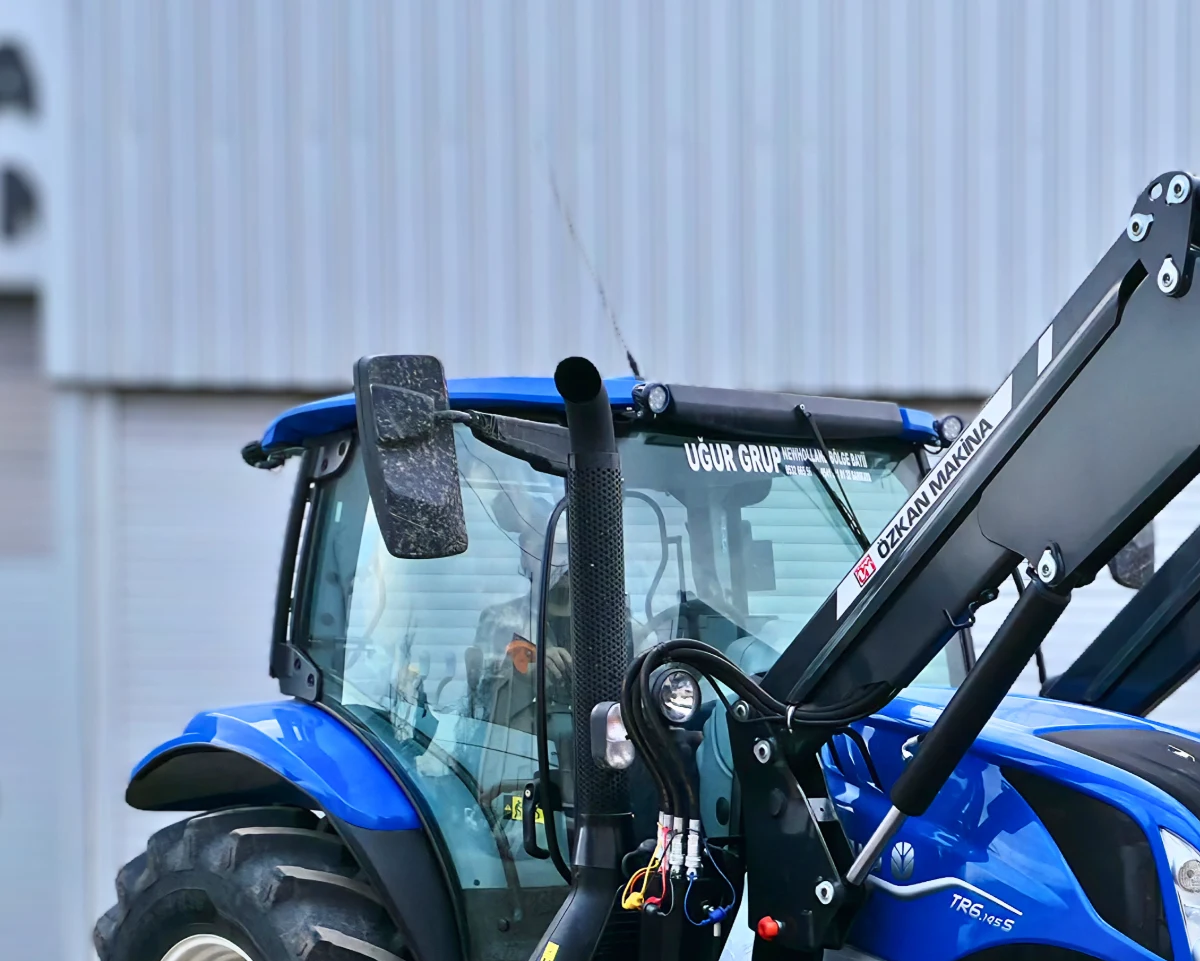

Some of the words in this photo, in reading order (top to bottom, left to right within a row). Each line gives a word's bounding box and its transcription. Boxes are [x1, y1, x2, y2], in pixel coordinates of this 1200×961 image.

[684, 436, 738, 472] UĞUR
[738, 443, 783, 474] GRUP
[828, 448, 851, 466] BÖLGE
[876, 491, 930, 559] ÖZKAN
[928, 418, 993, 497] MAKİNA
